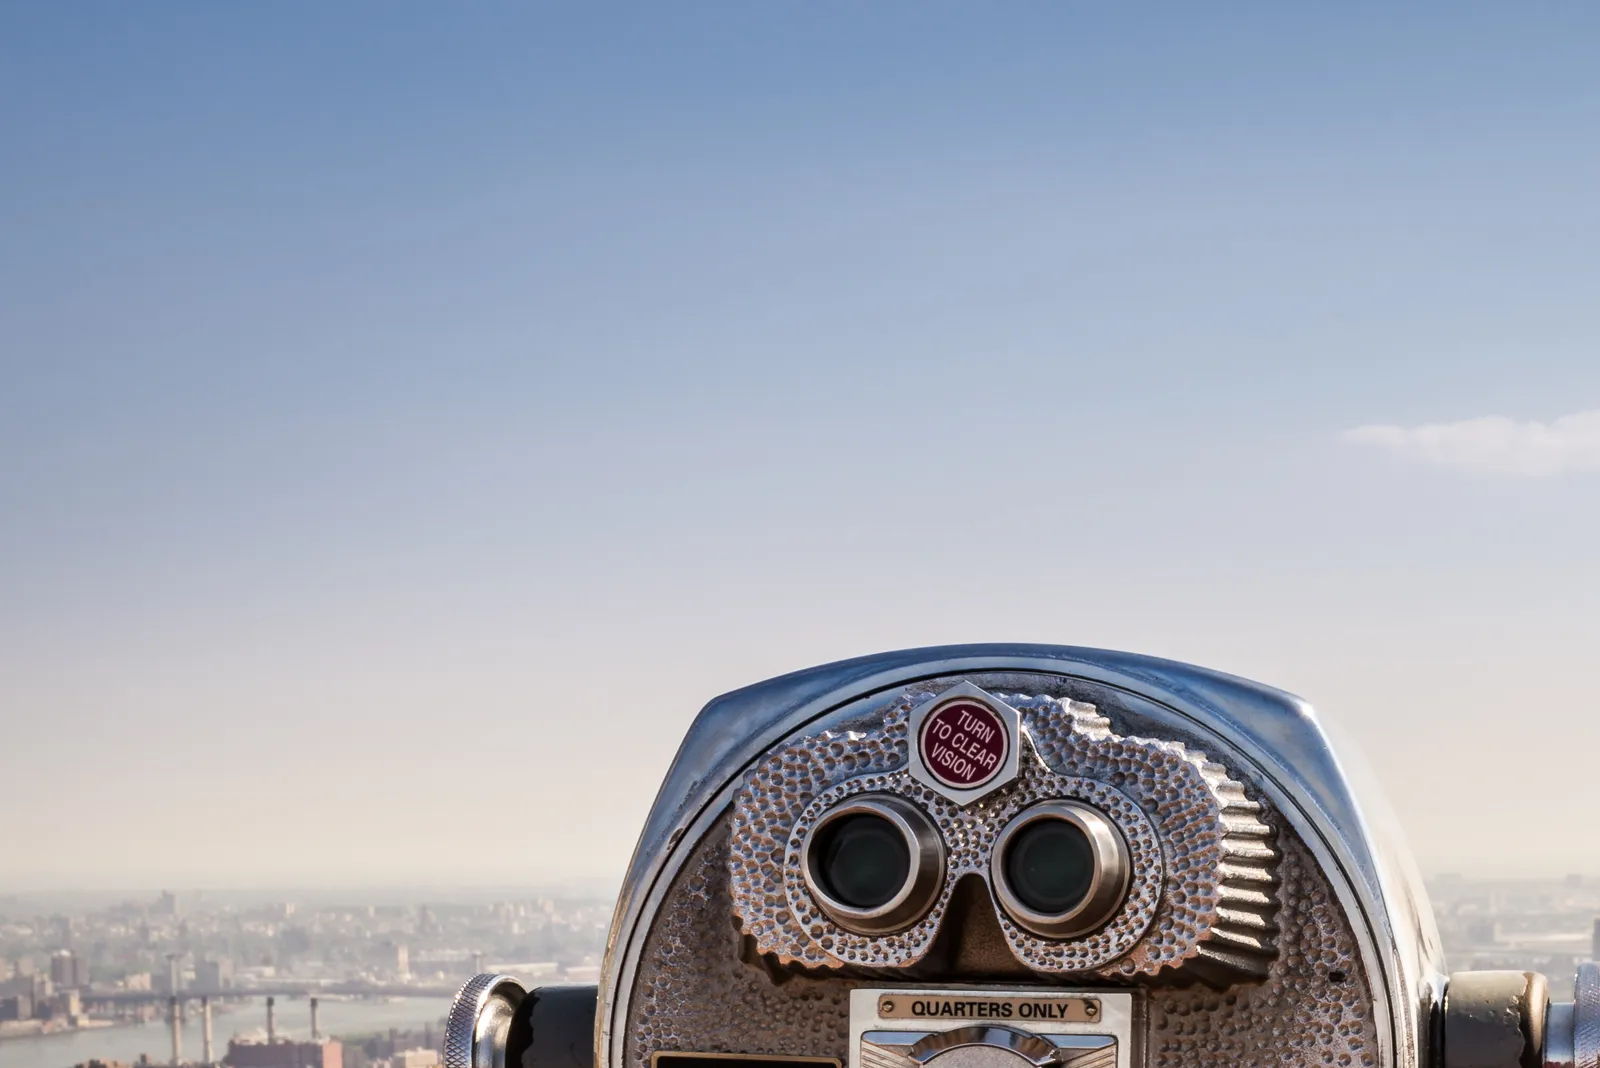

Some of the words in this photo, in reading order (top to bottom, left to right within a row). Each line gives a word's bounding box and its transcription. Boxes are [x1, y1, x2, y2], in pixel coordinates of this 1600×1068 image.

[932, 718, 952, 739] TO
[952, 733, 997, 770] CLEAR
[957, 710, 995, 743] TURN
[931, 743, 976, 780] VISION
[911, 1000, 1012, 1018] QUARTERS
[1018, 1002, 1069, 1019] ONLY
